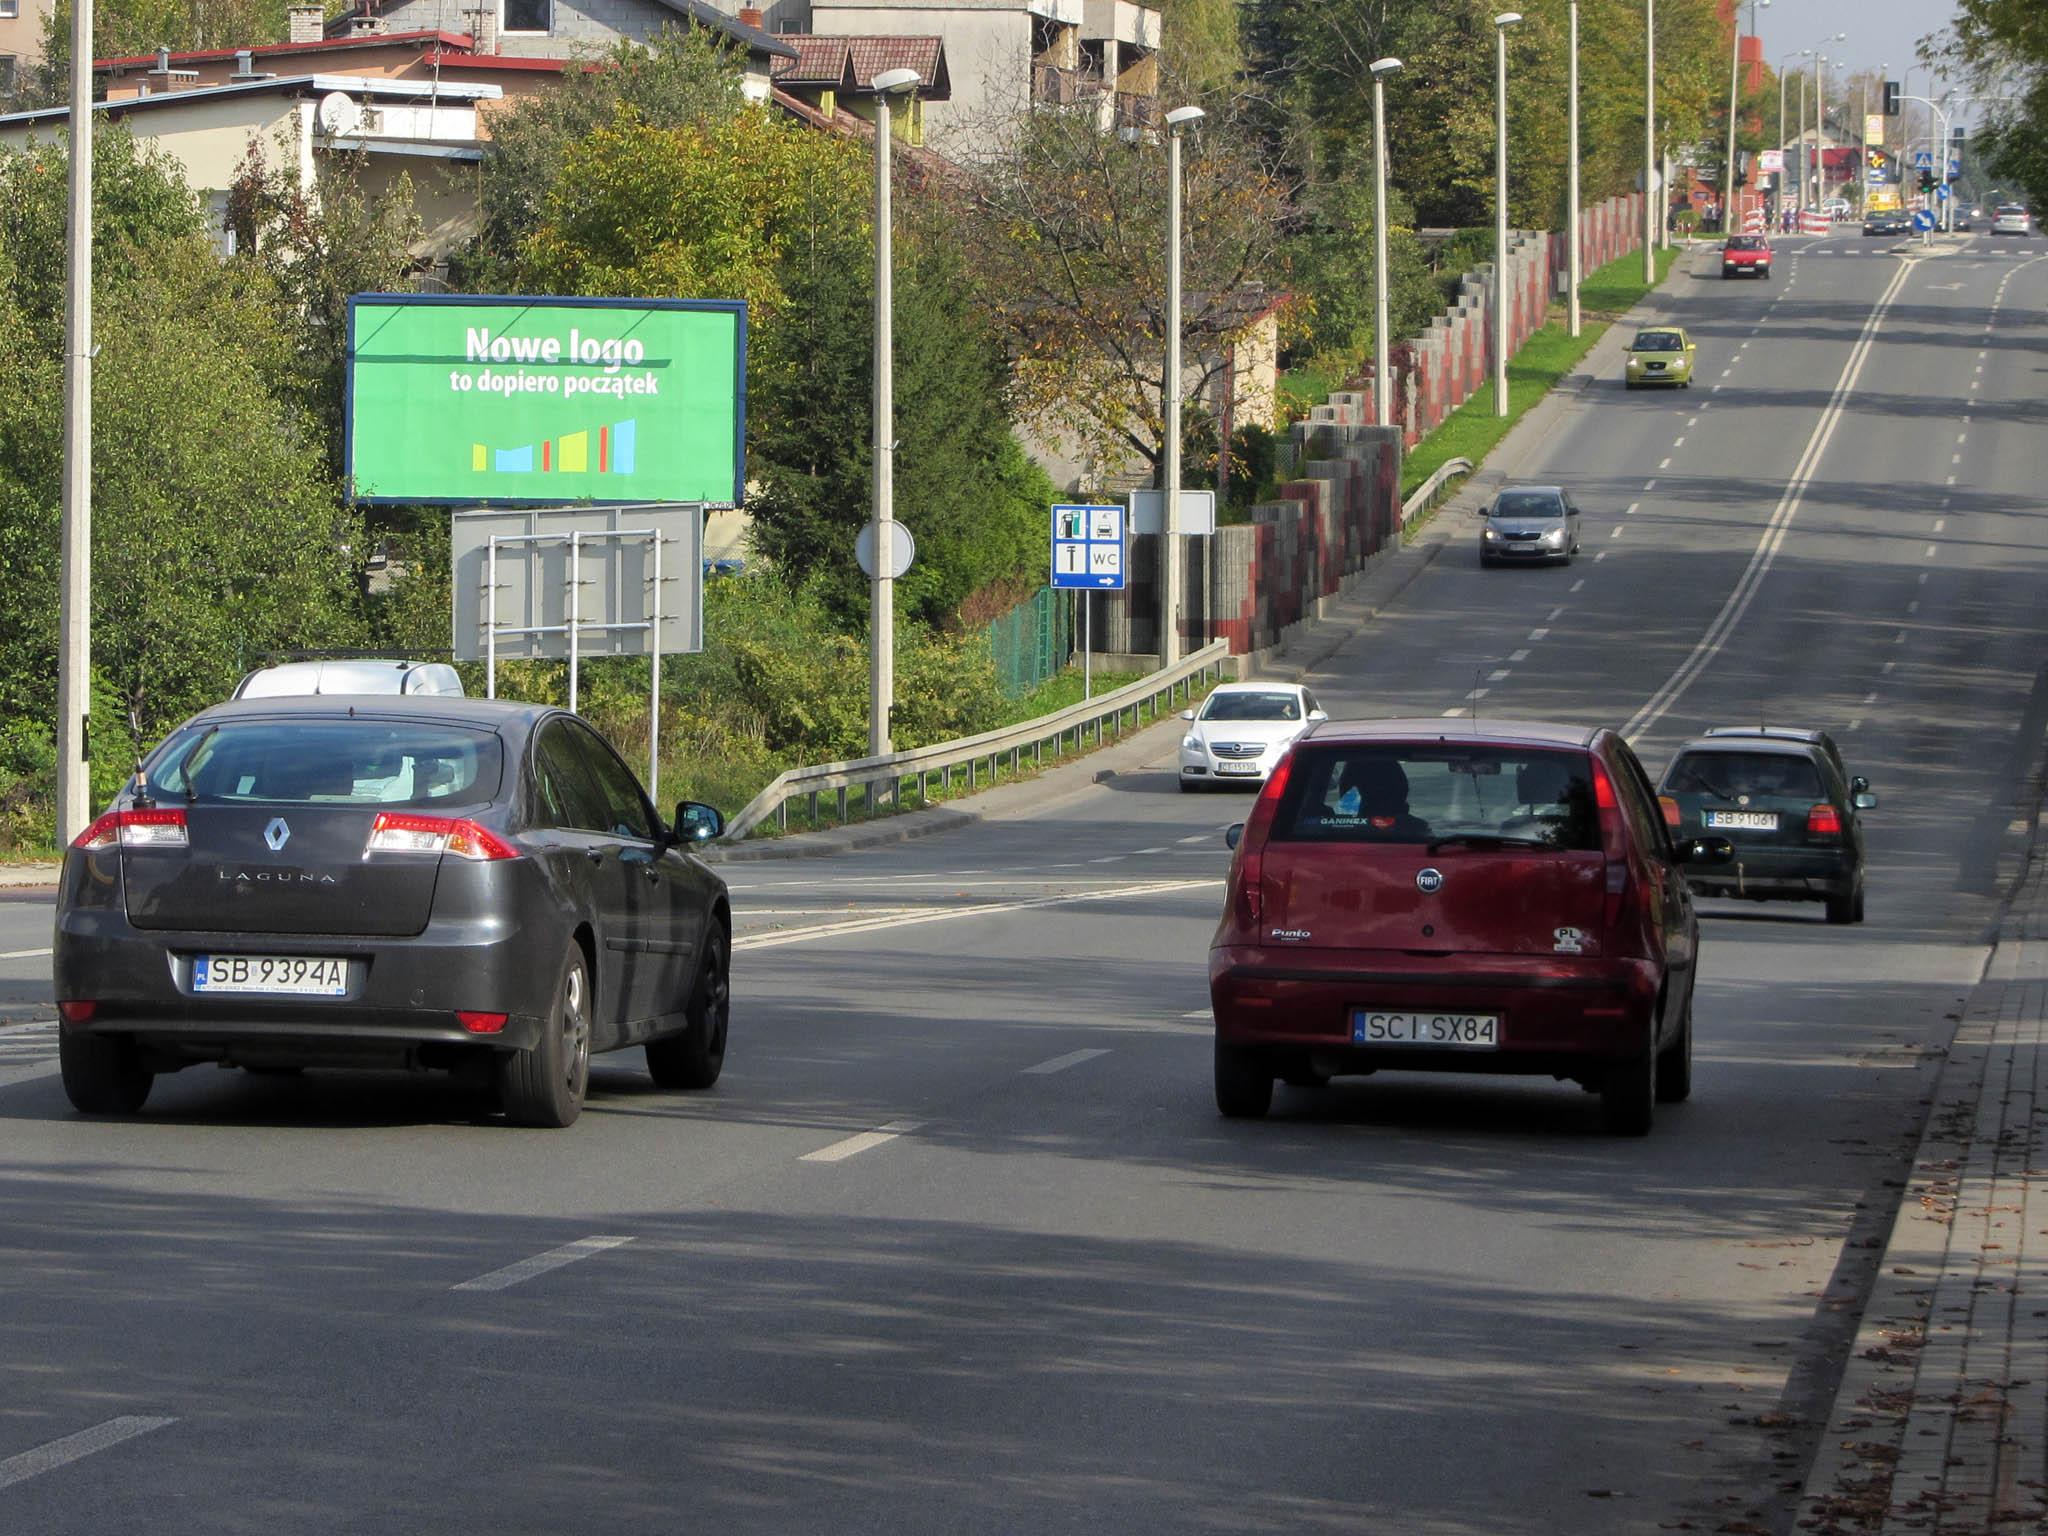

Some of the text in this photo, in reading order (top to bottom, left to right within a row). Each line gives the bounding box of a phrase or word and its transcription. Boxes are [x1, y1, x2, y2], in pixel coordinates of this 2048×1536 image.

[466, 328, 644, 373] Nowe logo
[450, 369, 659, 400] to dopiero początek
[1093, 553, 1117, 565] WC
[1716, 812, 1733, 825] SB
[219, 871, 336, 883] LAGUNA
[1420, 876, 1438, 886] FIAT
[1271, 928, 1311, 938] Punto
[1559, 928, 1577, 939] PL
[212, 958, 250, 983] SB
[260, 958, 342, 986] 9394A
[1369, 1015, 1417, 1040] SCI
[1432, 1016, 1494, 1042] SX84
